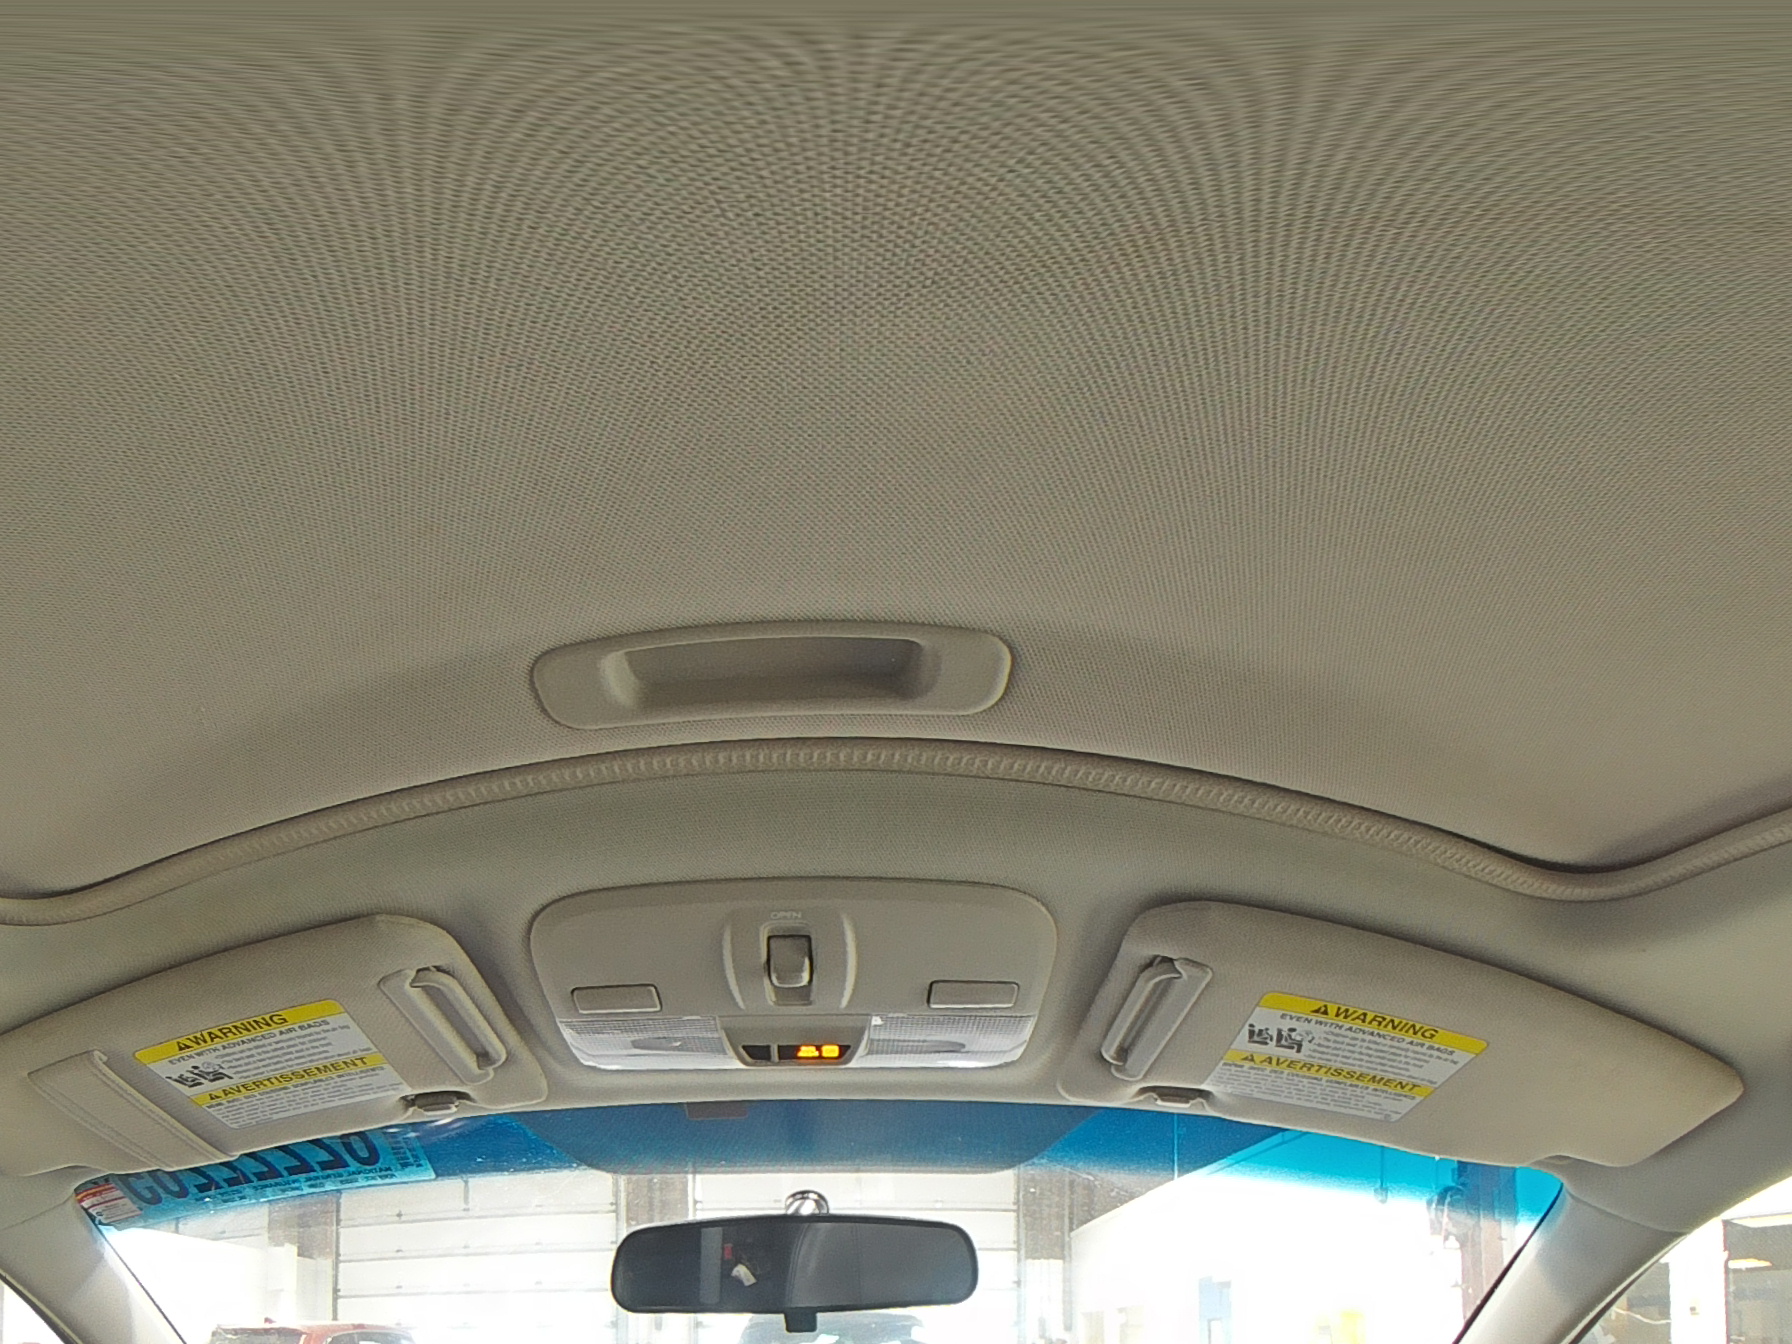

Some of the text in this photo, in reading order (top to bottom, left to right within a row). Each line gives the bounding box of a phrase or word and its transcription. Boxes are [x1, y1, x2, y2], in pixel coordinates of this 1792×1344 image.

[770, 911, 801, 919] OPEN
[168, 1019, 330, 1065] EVEN WITH ADVANCED AIR BAGS
[186, 1013, 288, 1046] WARNING
[1280, 1013, 1456, 1056] EVEN WITH ADVANCED AIR BAGS
[1334, 1006, 1439, 1041] WARNING
[221, 1056, 368, 1097] AVERTISSEMENT
[1259, 1055, 1422, 1093] AVERTISSEMENT
